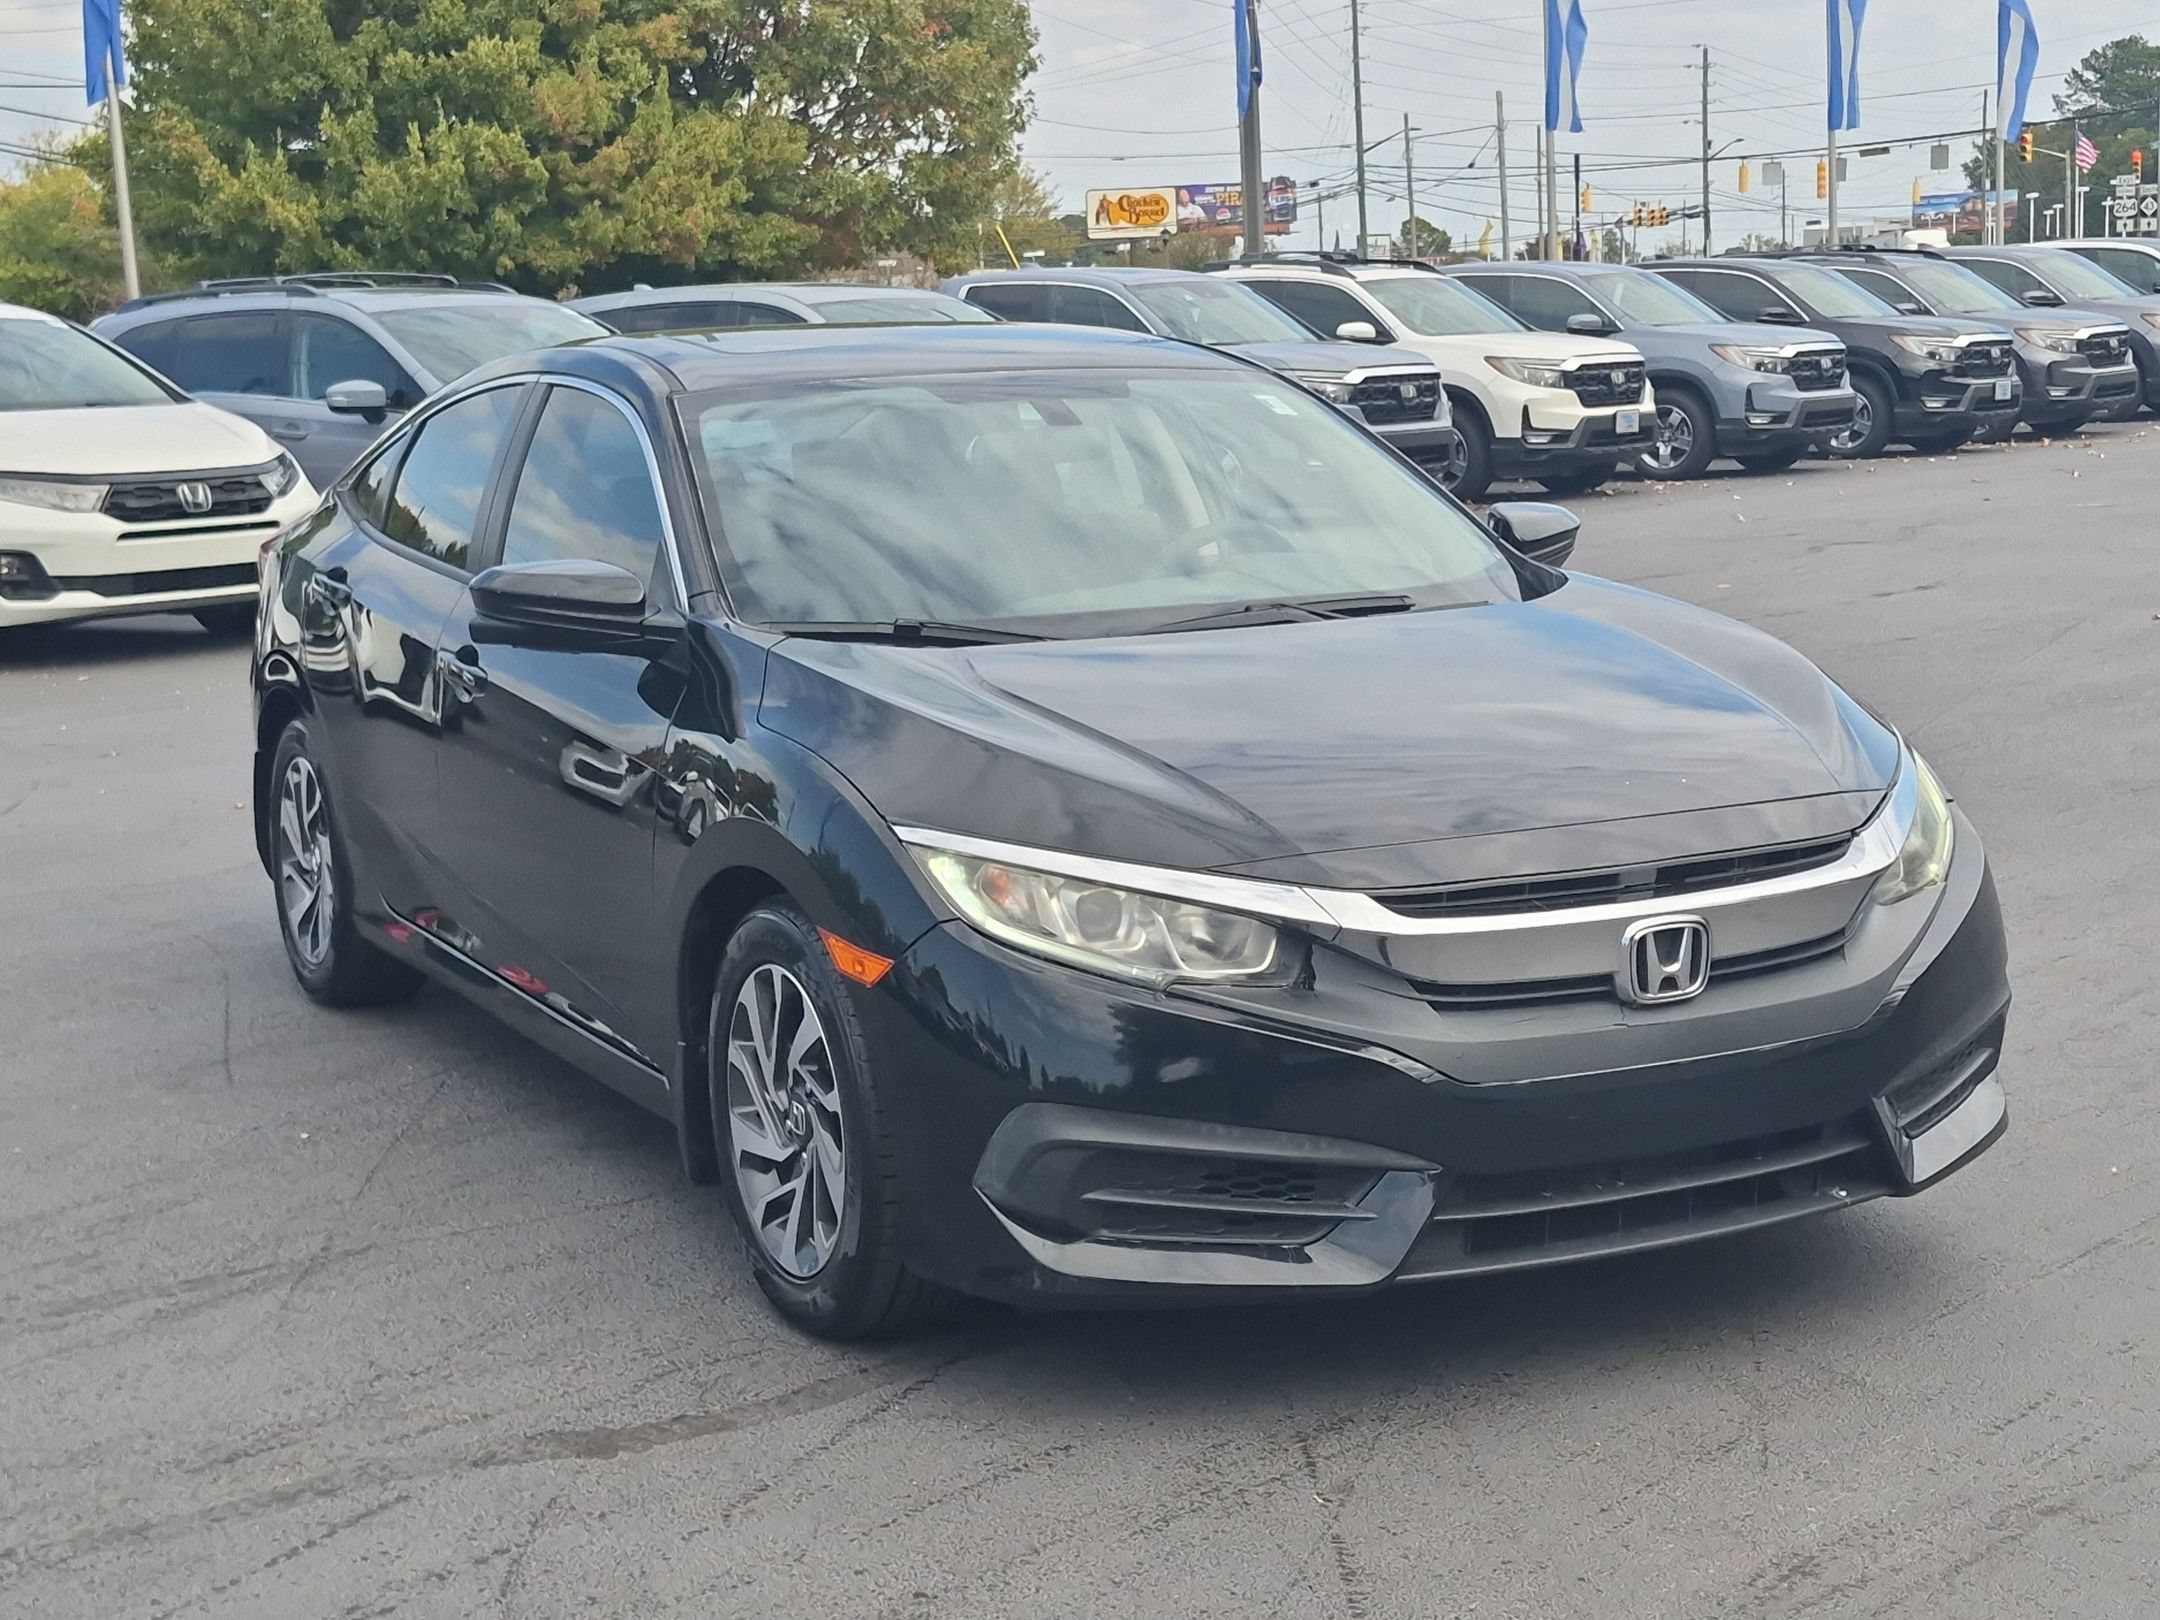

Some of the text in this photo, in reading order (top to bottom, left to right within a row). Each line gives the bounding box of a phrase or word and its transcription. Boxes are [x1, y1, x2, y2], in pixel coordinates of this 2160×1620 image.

[1117, 194, 1161, 212] Cracker
[2115, 202, 2136, 214] 264
[1128, 206, 1165, 224] Barrel
